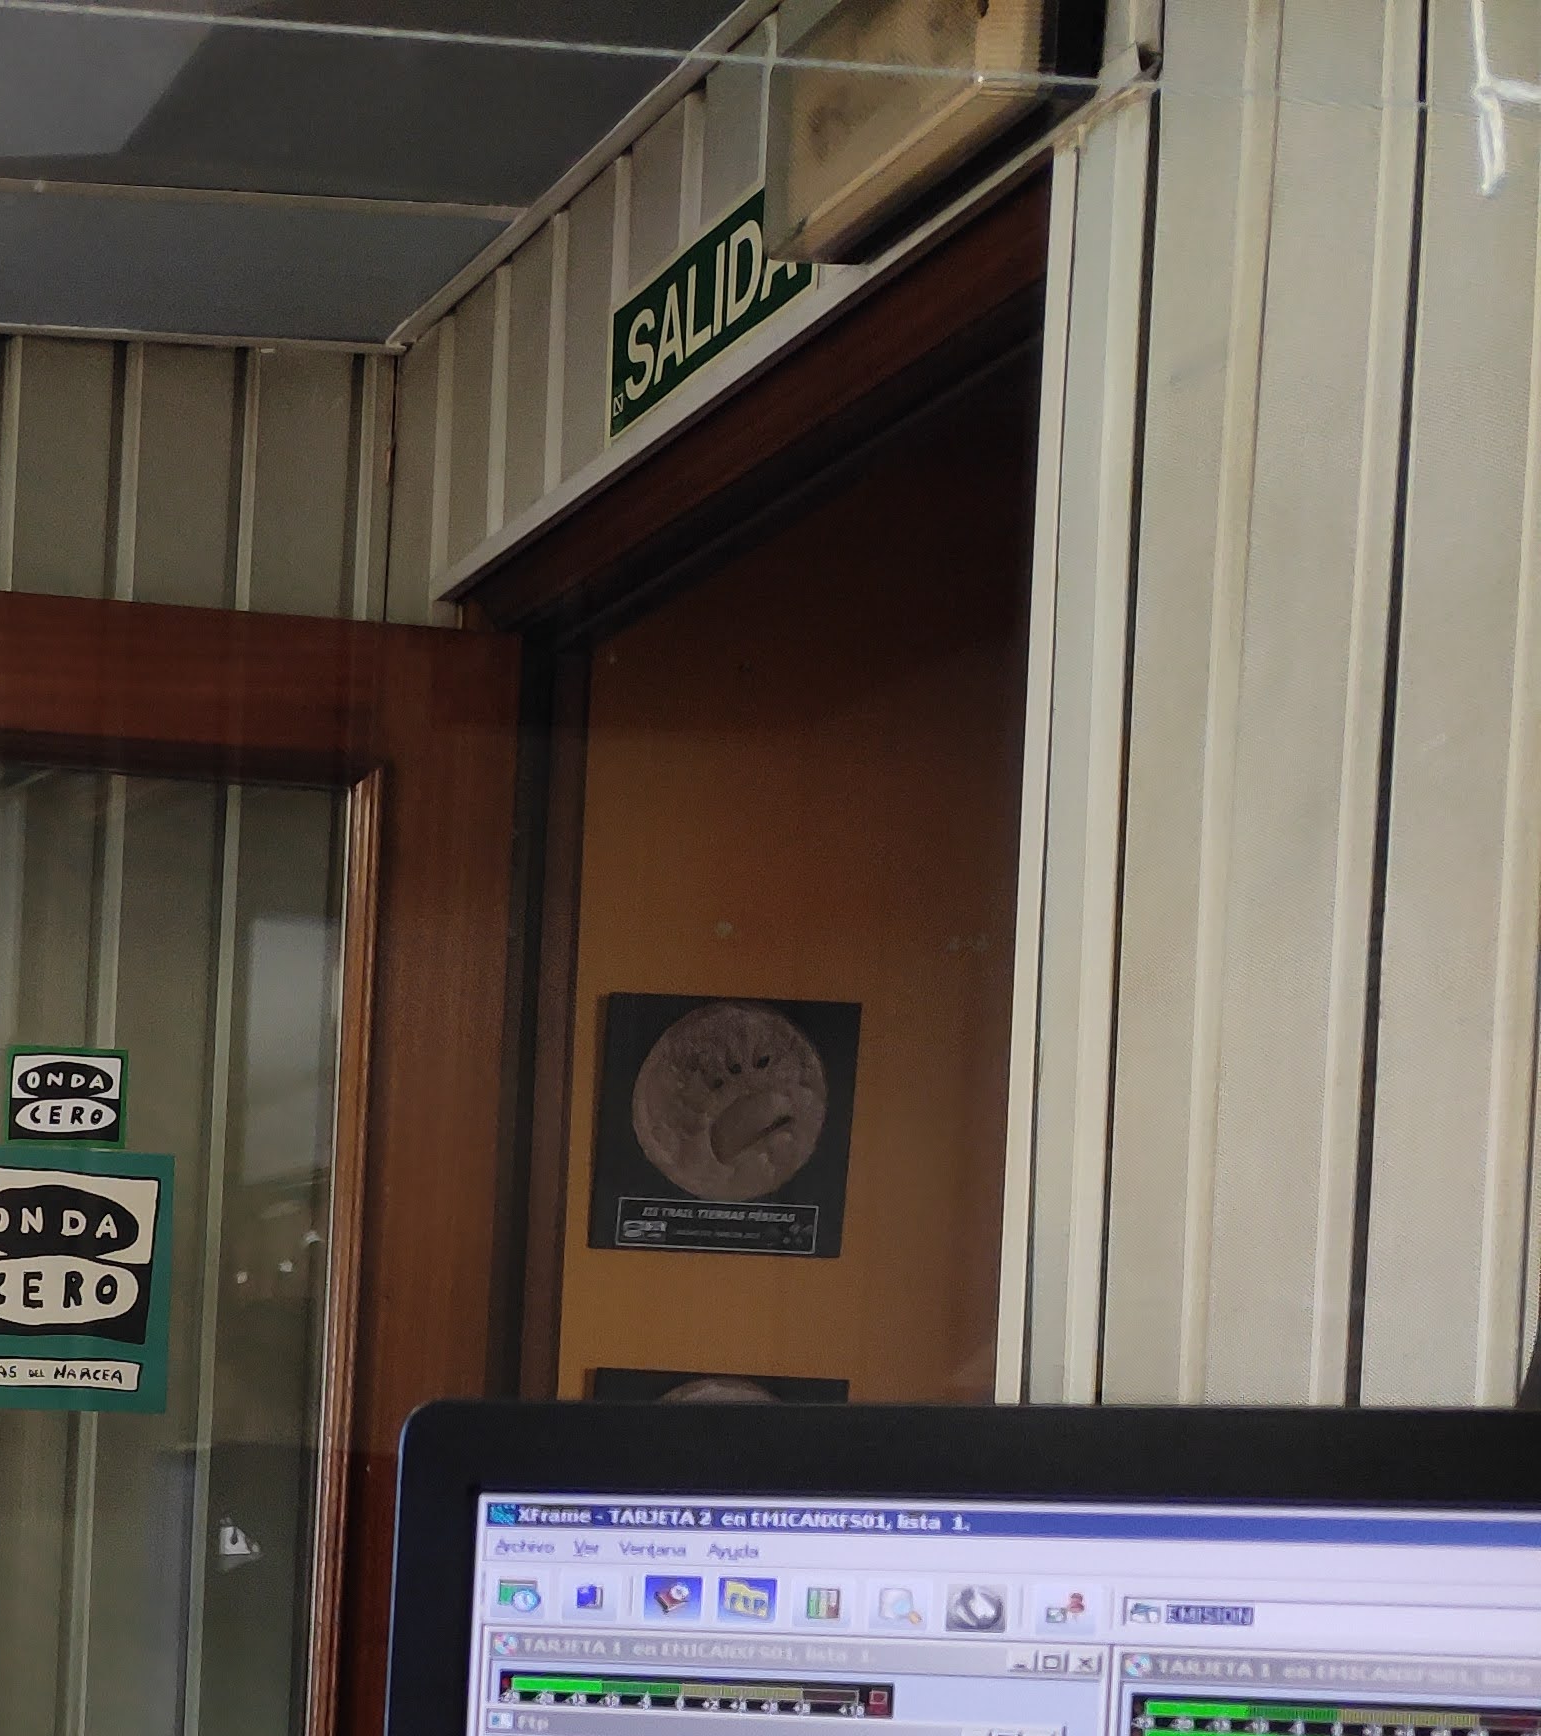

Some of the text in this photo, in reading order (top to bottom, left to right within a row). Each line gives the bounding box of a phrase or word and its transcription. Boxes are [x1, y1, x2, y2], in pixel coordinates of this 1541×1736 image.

[625, 219, 798, 401] SALID
[26, 1071, 106, 1090] ONDA
[30, 1105, 104, 1126] CERO
[54, 1366, 124, 1384] NARCEA
[609, 1509, 696, 1526] TARJETA
[699, 1510, 712, 1526] 2
[721, 1514, 746, 1527] en
[573, 1539, 599, 1556] Ver
[707, 1543, 760, 1561] Ayuda
